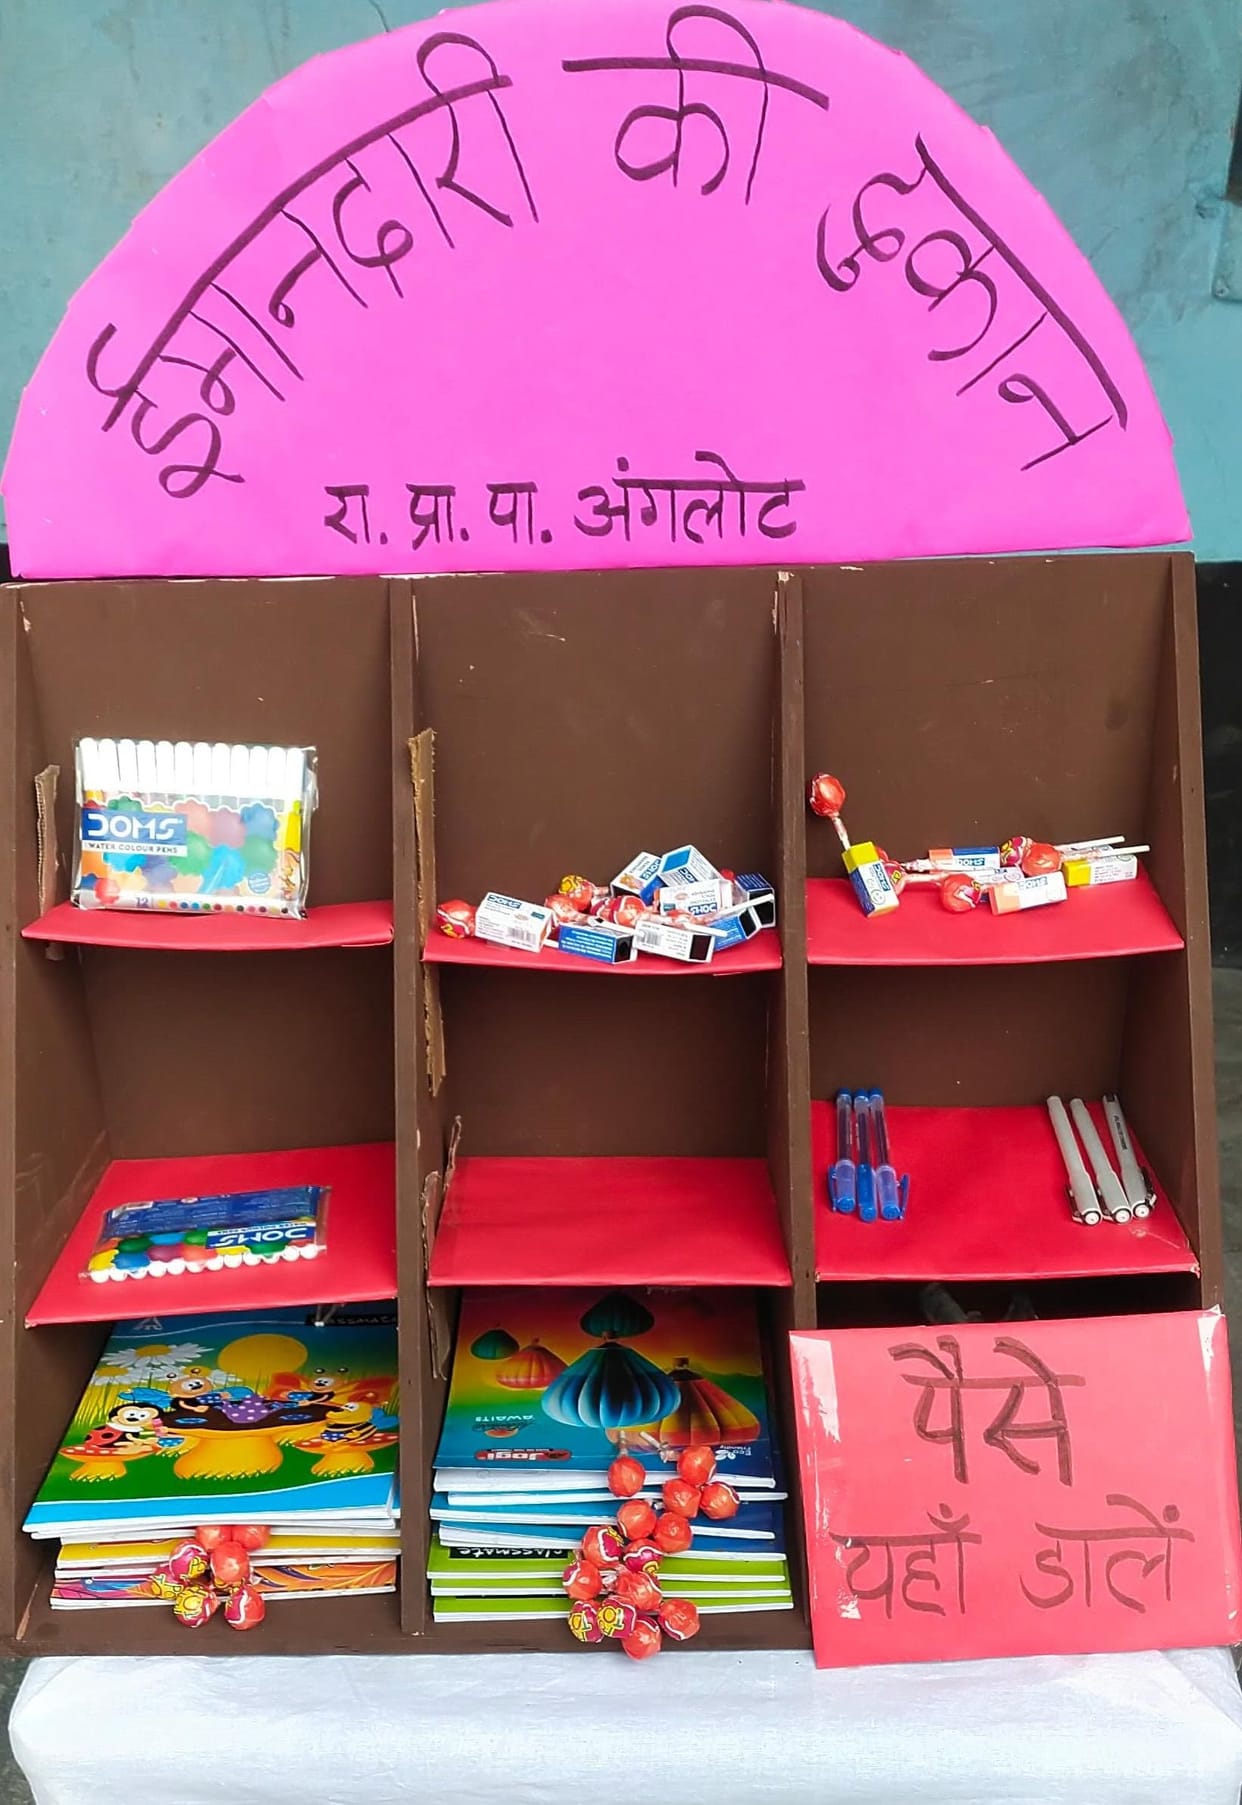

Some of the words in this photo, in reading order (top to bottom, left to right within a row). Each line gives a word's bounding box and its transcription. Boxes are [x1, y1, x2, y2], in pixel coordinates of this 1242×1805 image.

[87, 32, 539, 498] ईमानदारी
[562, 4, 829, 205] की
[816, 132, 1128, 471] दुकान
[324, 484, 387, 546] रा.
[406, 483, 470, 551] प्रा.
[486, 482, 552, 545] पा.
[574, 450, 806, 545] अंगलोट
[87, 813, 184, 840] DOMS
[88, 842, 116, 850] WATER
[118, 843, 154, 853] COLOUR
[156, 845, 178, 854] PENS
[136, 896, 149, 908] 12
[209, 1227, 308, 1248] DOMS
[888, 1335, 1086, 1487] पैसे
[829, 1503, 982, 1619] यहाँ
[1019, 1494, 1195, 1613] डालें
